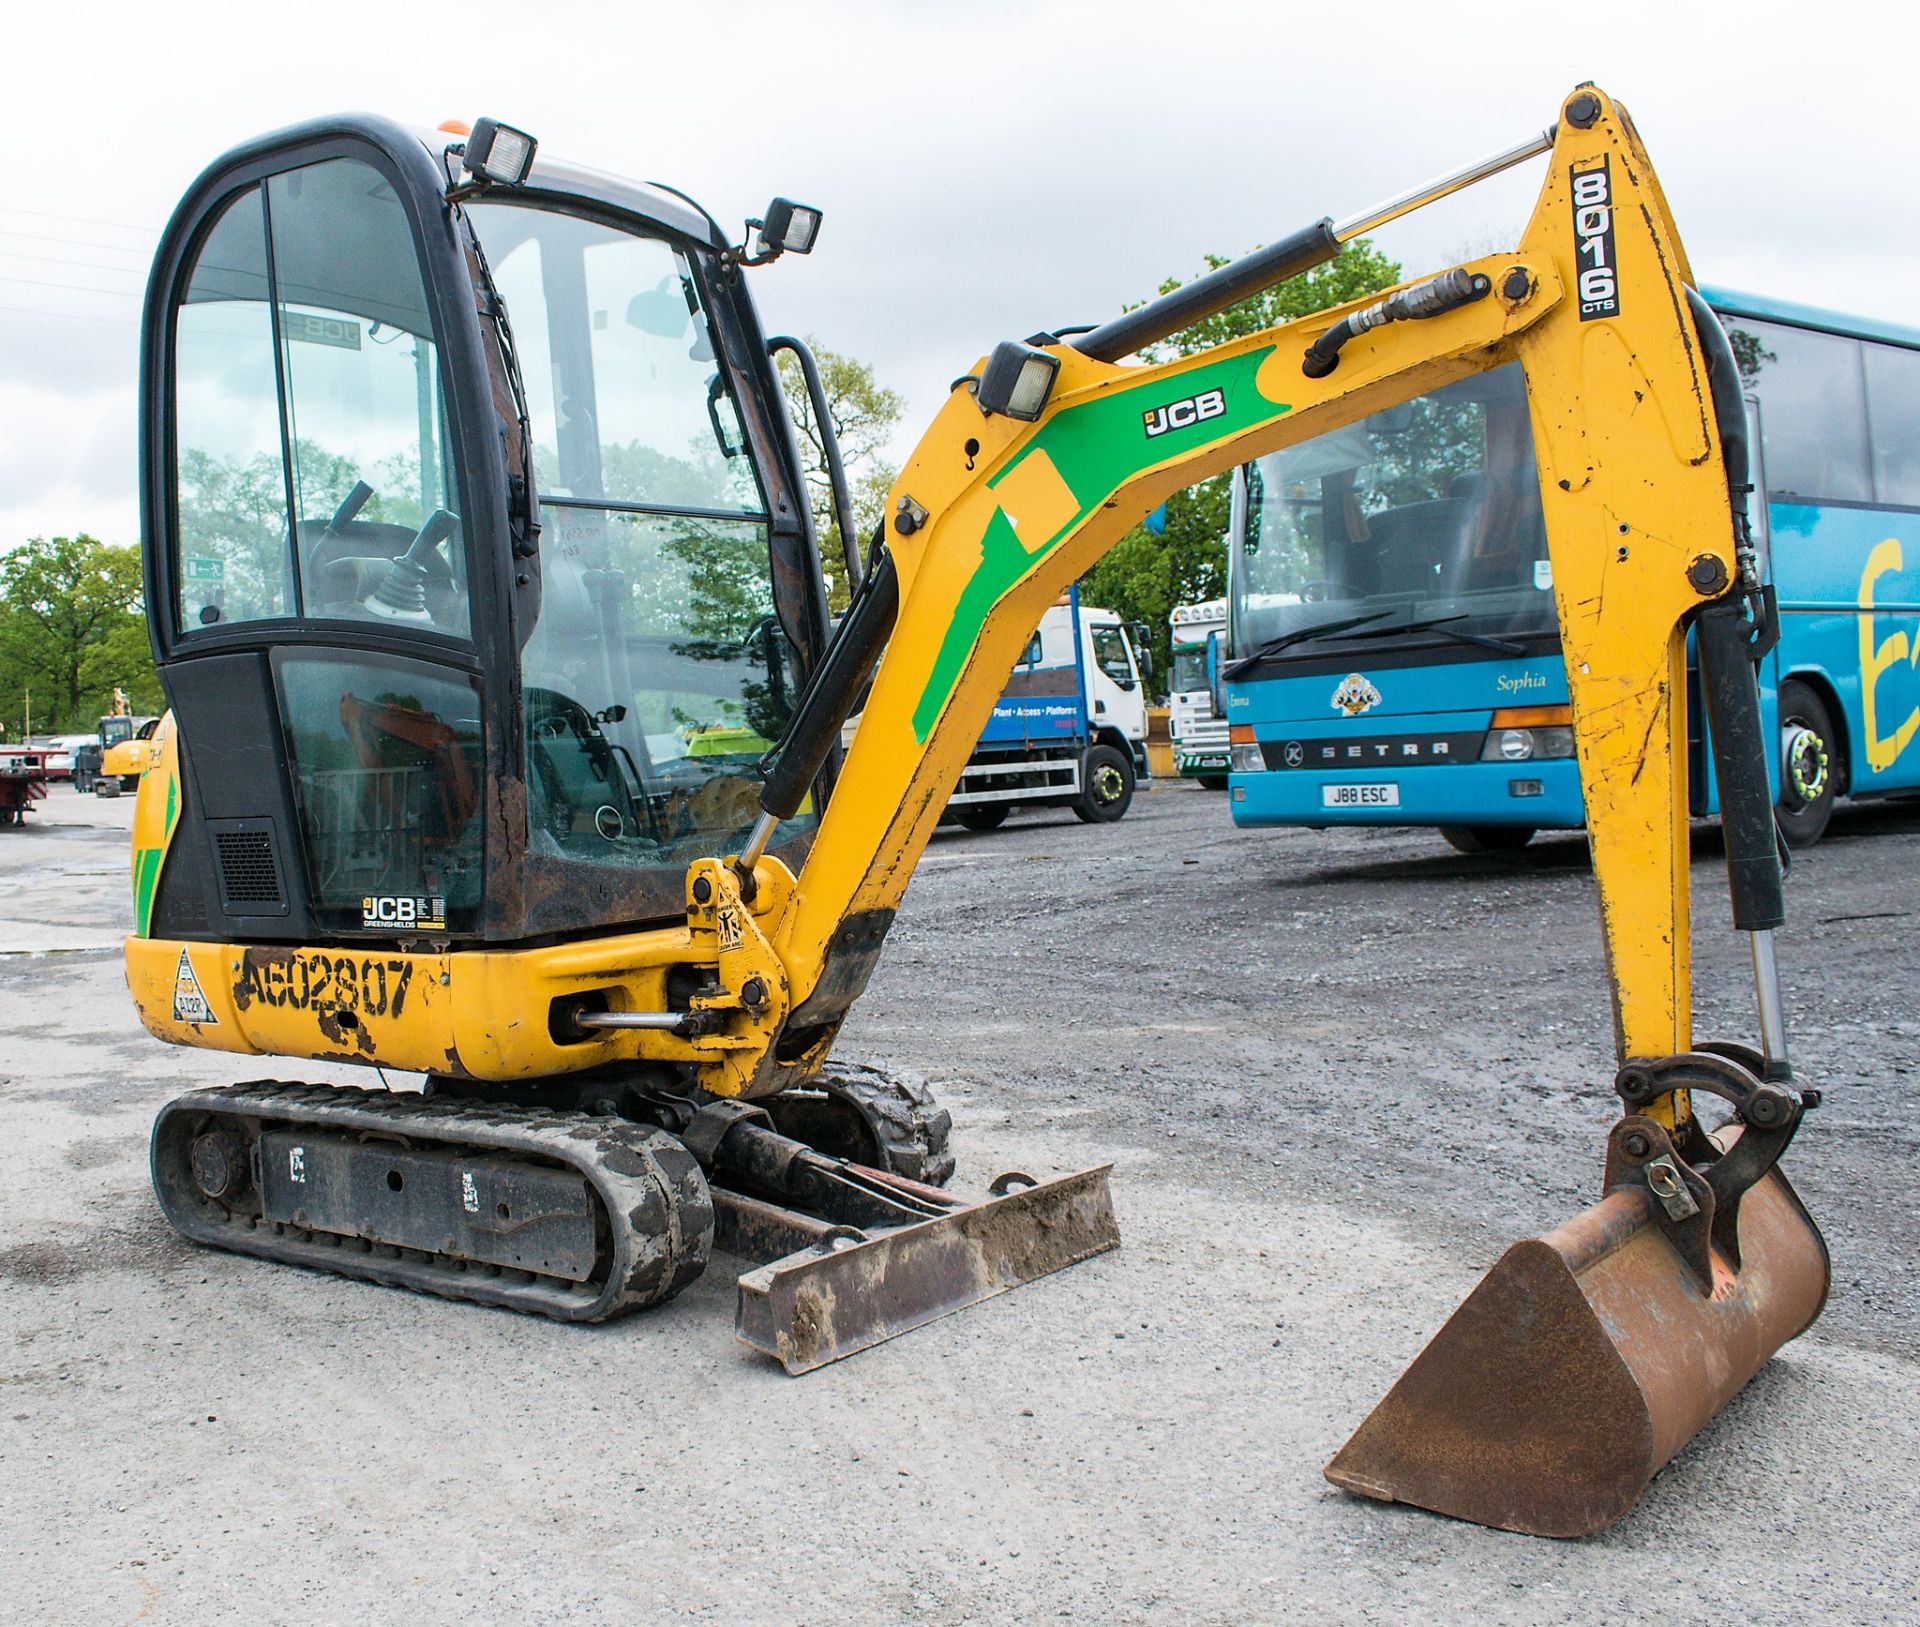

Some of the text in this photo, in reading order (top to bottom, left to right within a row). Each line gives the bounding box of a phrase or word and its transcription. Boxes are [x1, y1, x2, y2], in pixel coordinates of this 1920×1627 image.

[1573, 172, 1615, 302] 8016
[1582, 300, 1615, 314] CTS
[1145, 390, 1225, 436] JCB
[1496, 670, 1546, 695] Sophia
[993, 707, 1012, 717] Plant
[1321, 742, 1449, 759] SETRA
[1334, 787, 1388, 803] J88 ESC
[363, 897, 416, 921] JCB
[363, 920, 416, 929] GREENSHIELDS
